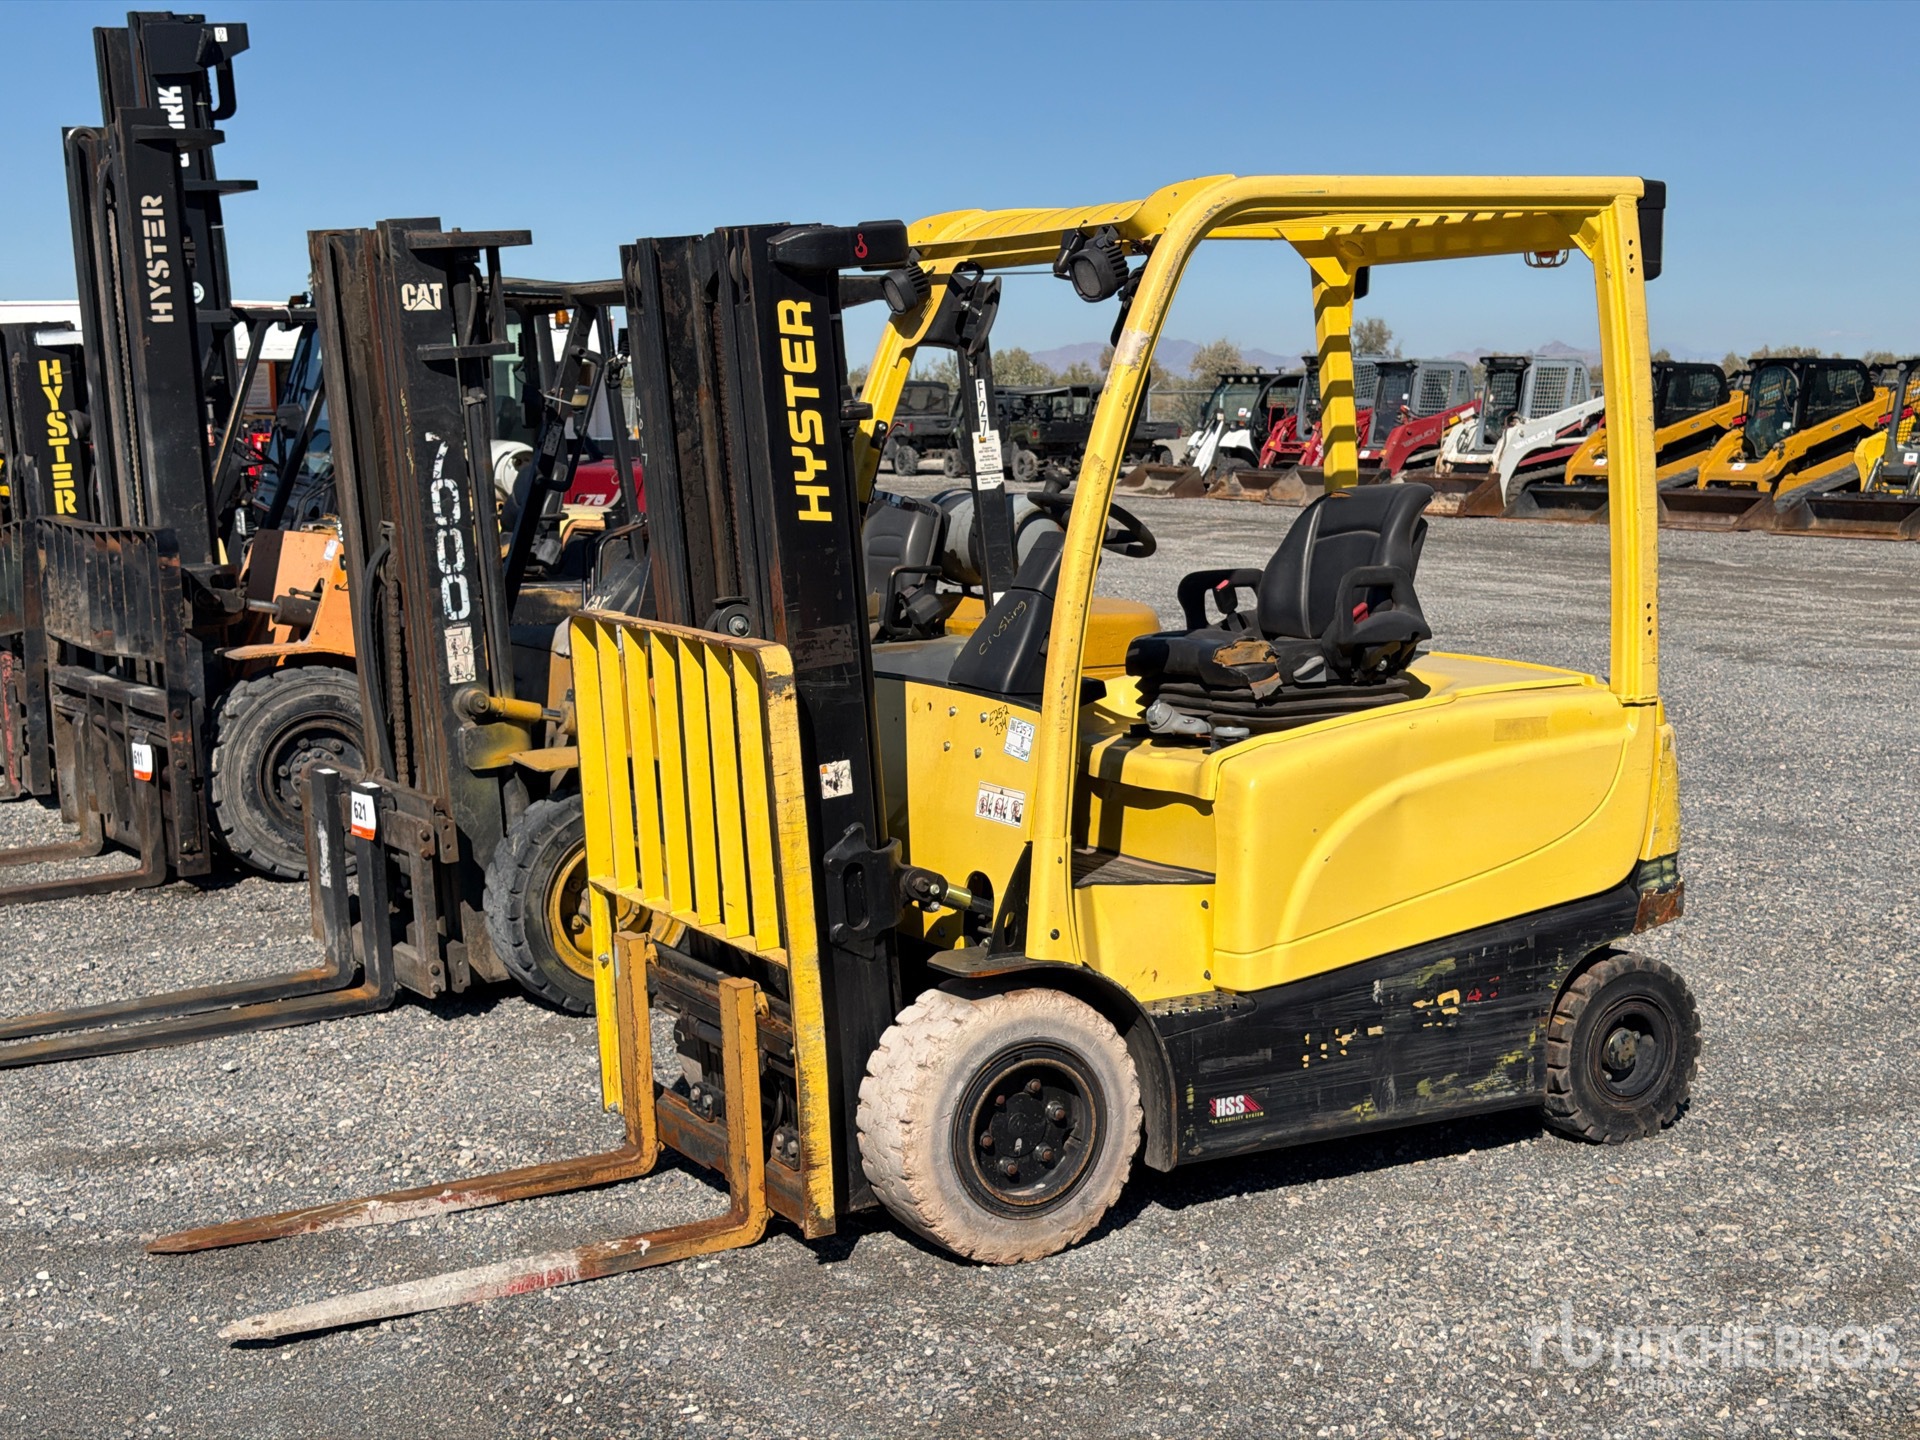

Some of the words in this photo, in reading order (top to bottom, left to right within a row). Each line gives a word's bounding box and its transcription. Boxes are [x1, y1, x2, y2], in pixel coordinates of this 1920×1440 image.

[141, 194, 174, 323] HYSTER
[401, 283, 443, 311] CAT
[38, 359, 77, 515] HYSTER
[777, 299, 833, 522] HYSTER
[353, 800, 367, 822] 621
[1215, 1094, 1245, 1117] HSS
